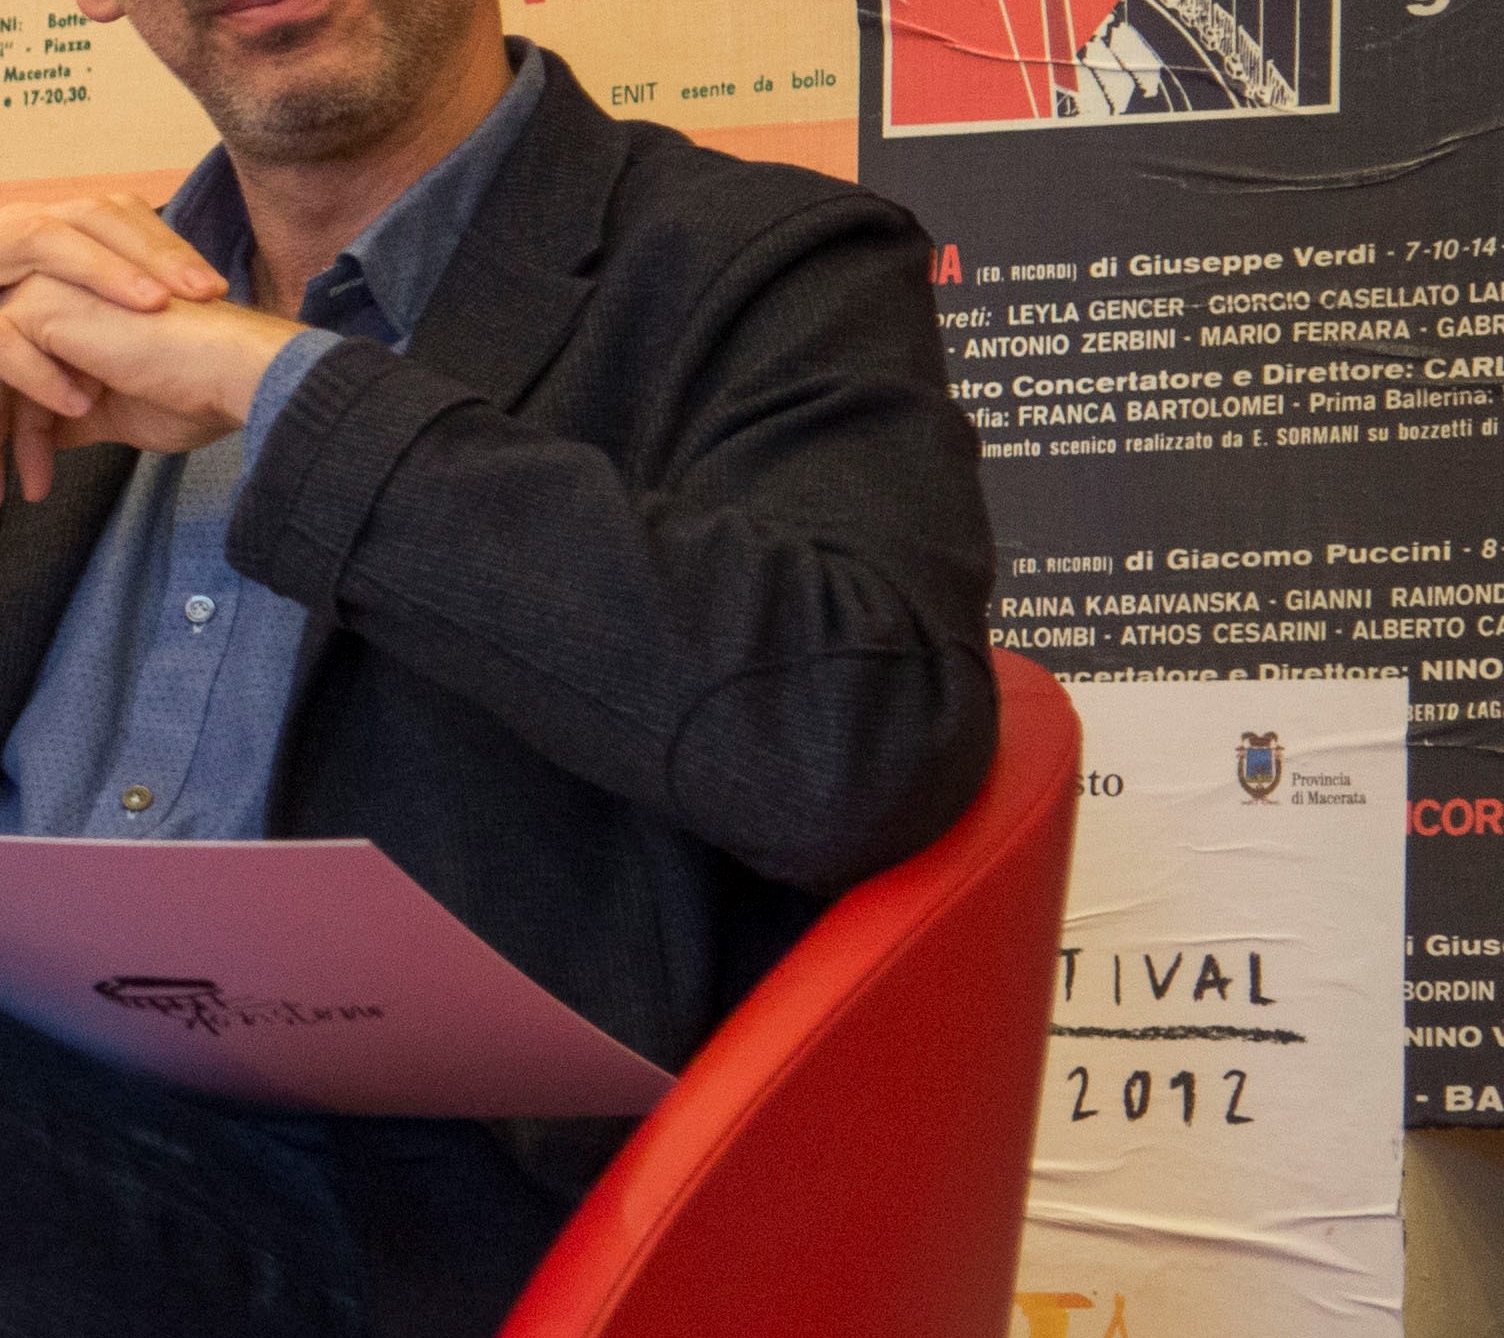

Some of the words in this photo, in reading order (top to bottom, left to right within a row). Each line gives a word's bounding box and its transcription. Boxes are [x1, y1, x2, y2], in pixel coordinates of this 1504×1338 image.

[611, 82, 657, 105] ENIT
[681, 80, 736, 100] esente
[753, 74, 773, 93] da
[792, 69, 836, 89] bollo
[1090, 257, 1117, 278] di
[1129, 251, 1284, 276] Giuseppe
[1294, 242, 1376, 267] Verdi
[1008, 302, 1080, 326] LEYLA
[1088, 297, 1184, 321] GENCER
[1208, 291, 1311, 315] GIORGIO
[1320, 284, 1460, 309] CASELLATO
[964, 334, 1069, 359] ANTONIO
[1081, 329, 1176, 354] ZERBINI
[1200, 323, 1281, 346] MARIO
[1293, 319, 1410, 342] FERRARA
[1012, 371, 1222, 399] Concertatore
[1263, 362, 1413, 385] Direttore:
[1018, 401, 1116, 427] FRANCA
[1127, 394, 1284, 422] BARTOLOMEI
[1309, 391, 1376, 413] Prima
[1385, 387, 1494, 410] Ballerina:
[1050, 437, 1116, 457] scenico
[1125, 432, 1212, 452] realizzato
[1276, 425, 1358, 446] SORMANI
[1399, 418, 1472, 441] bozzetti
[1125, 551, 1153, 571] di
[1167, 547, 1313, 570] Giacomo
[1326, 540, 1451, 565] Puccini
[1002, 596, 1075, 618] RAINA
[1086, 591, 1260, 616] KABAIVANSKA
[1286, 588, 1372, 610] GIANNI
[1121, 624, 1201, 646] ATHOS
[1212, 620, 1327, 645] CESARINI
[1352, 617, 1465, 640] ALBERTO
[1291, 772, 1351, 787] Provincia
[1308, 791, 1366, 805] Macerata
[1067, 1067, 1255, 1126] 2012
